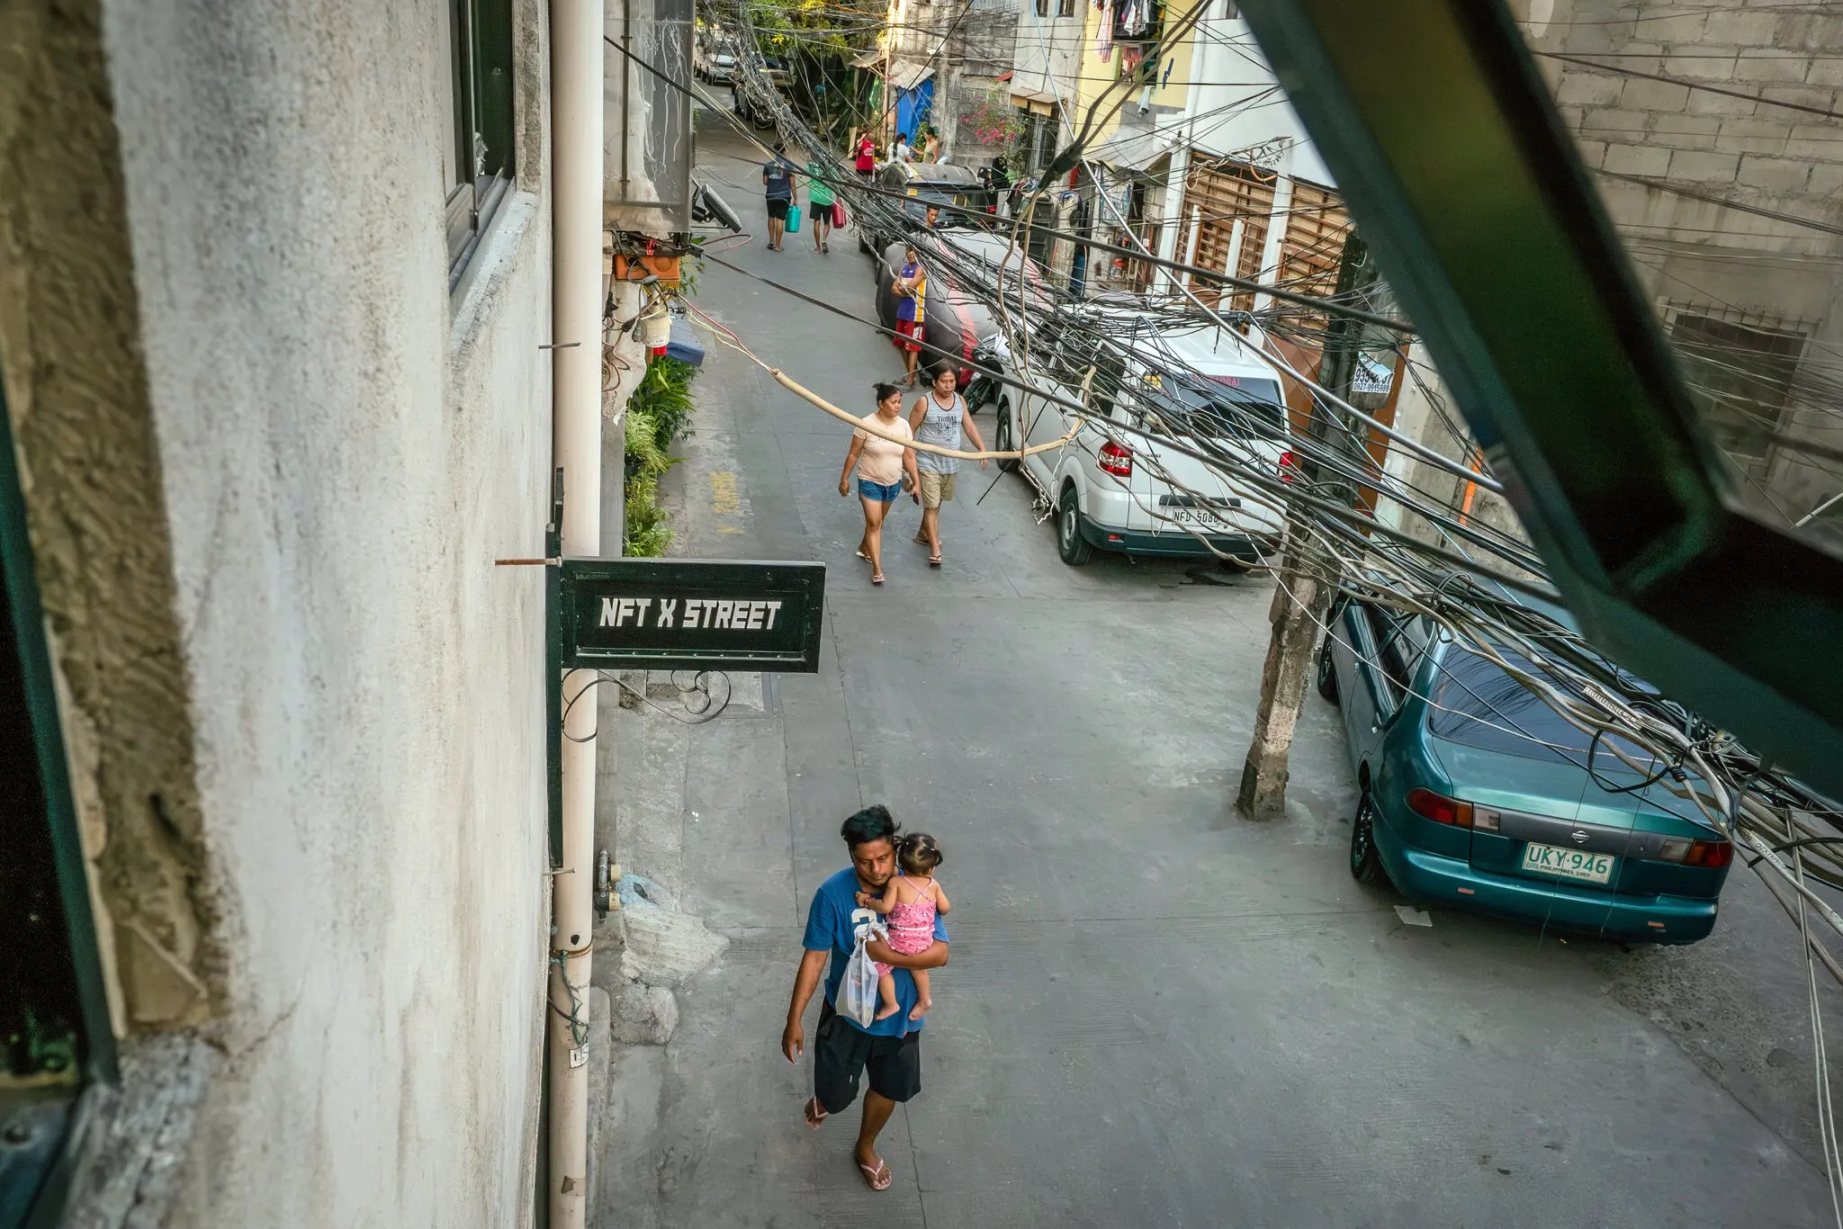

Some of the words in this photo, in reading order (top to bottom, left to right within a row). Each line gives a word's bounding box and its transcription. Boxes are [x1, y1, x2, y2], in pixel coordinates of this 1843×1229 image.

[1174, 511, 1191, 522] NFD
[600, 597, 652, 627] NFT
[657, 598, 677, 628] X
[682, 599, 782, 630] STREET
